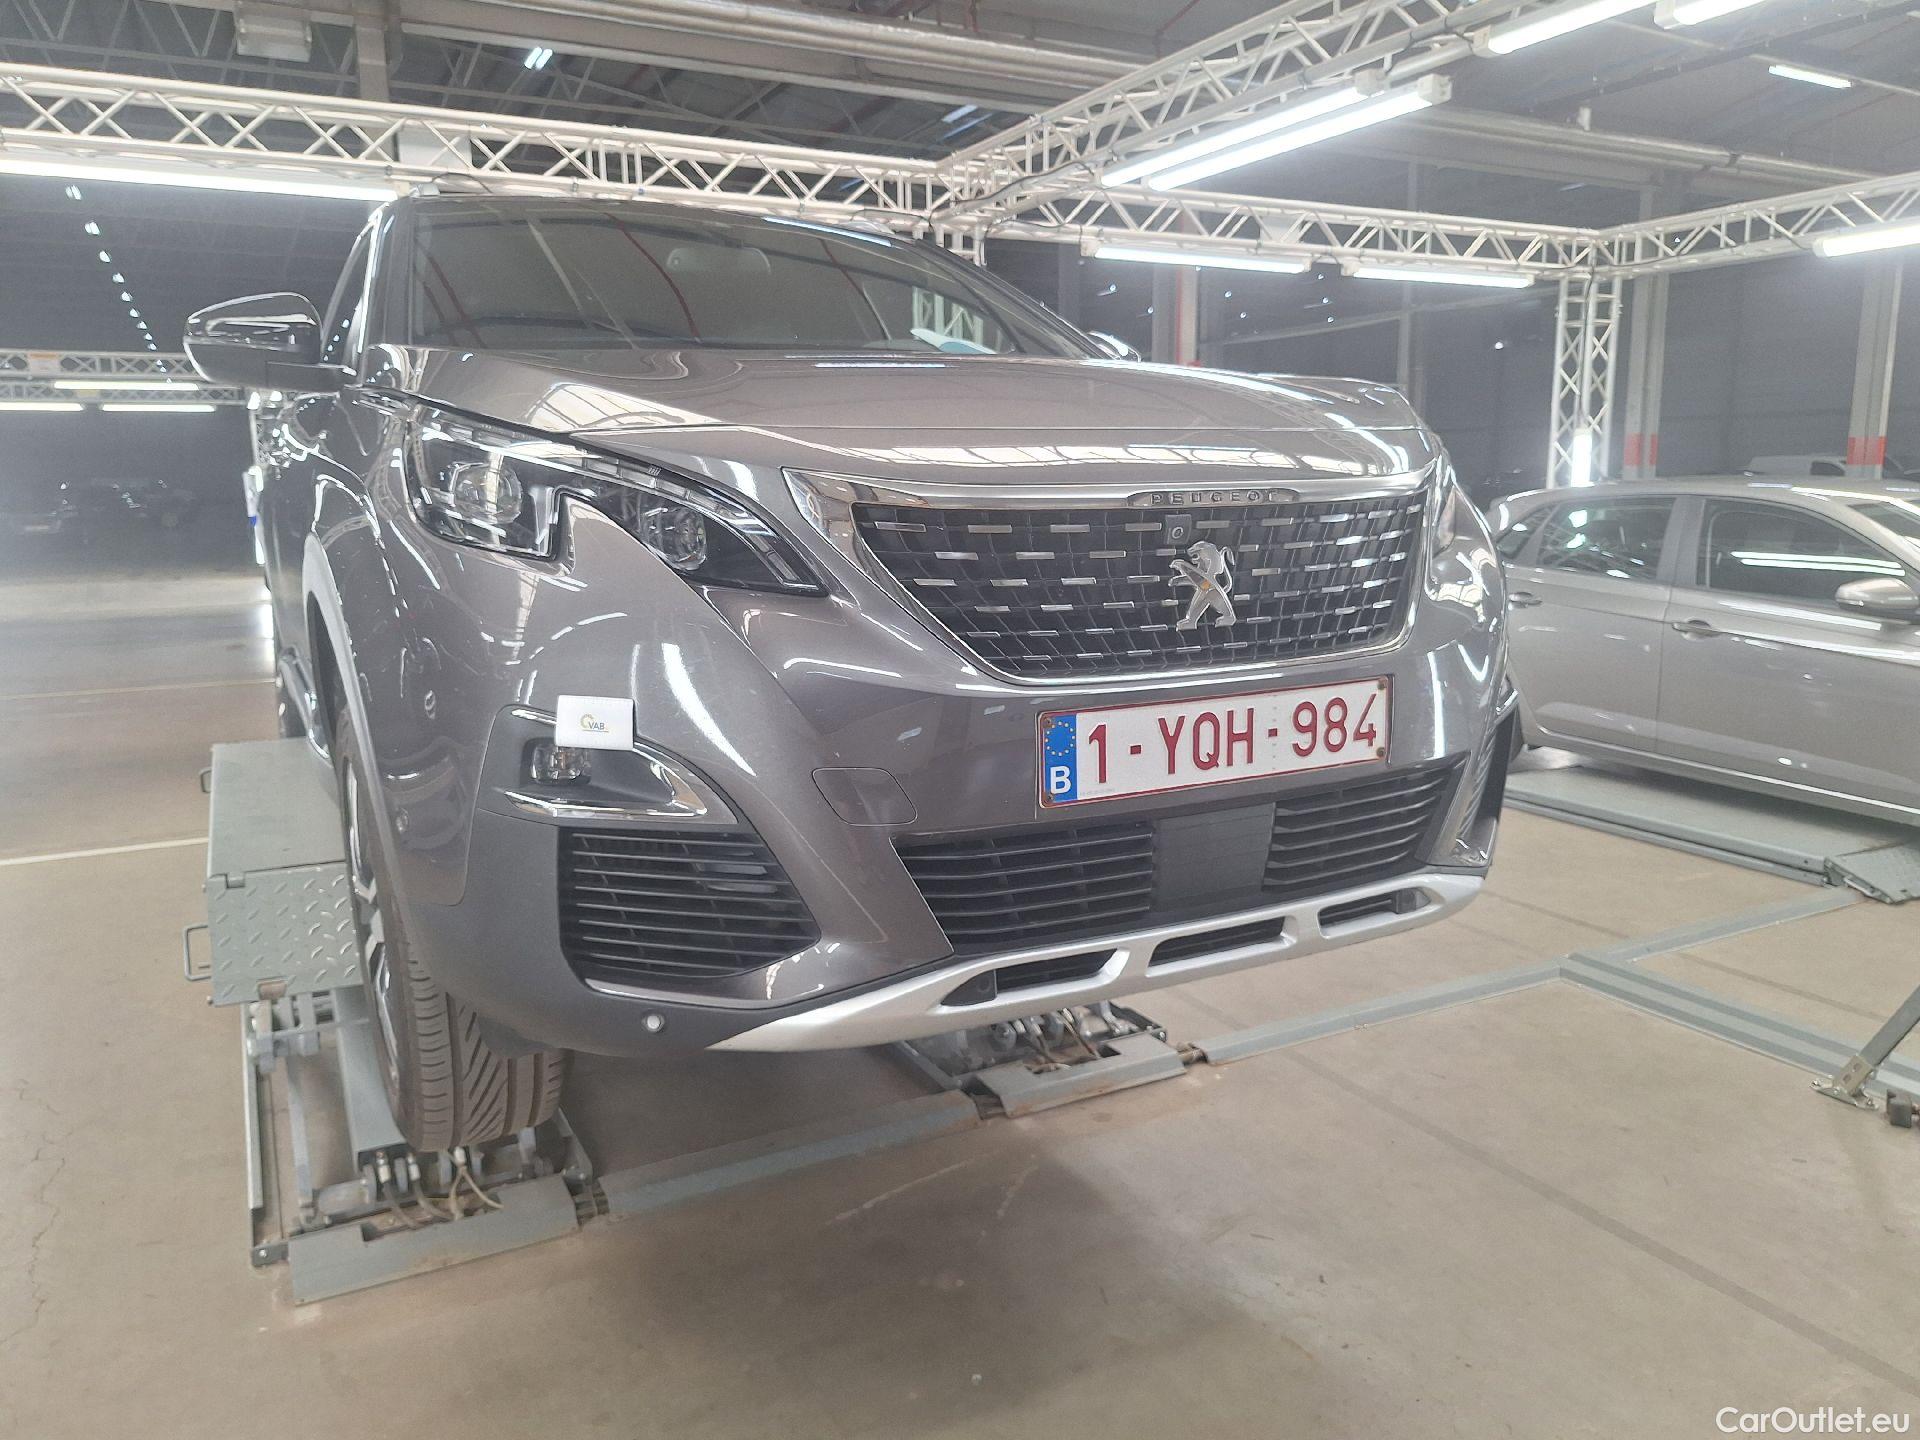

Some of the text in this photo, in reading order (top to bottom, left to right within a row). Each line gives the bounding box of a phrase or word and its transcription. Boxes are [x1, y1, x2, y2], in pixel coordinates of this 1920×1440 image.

[1150, 489, 1278, 506] PEUGEOT
[588, 721, 605, 731] VAB
[1088, 693, 1377, 784] 1-YQH-984
[1049, 765, 1072, 795] B
